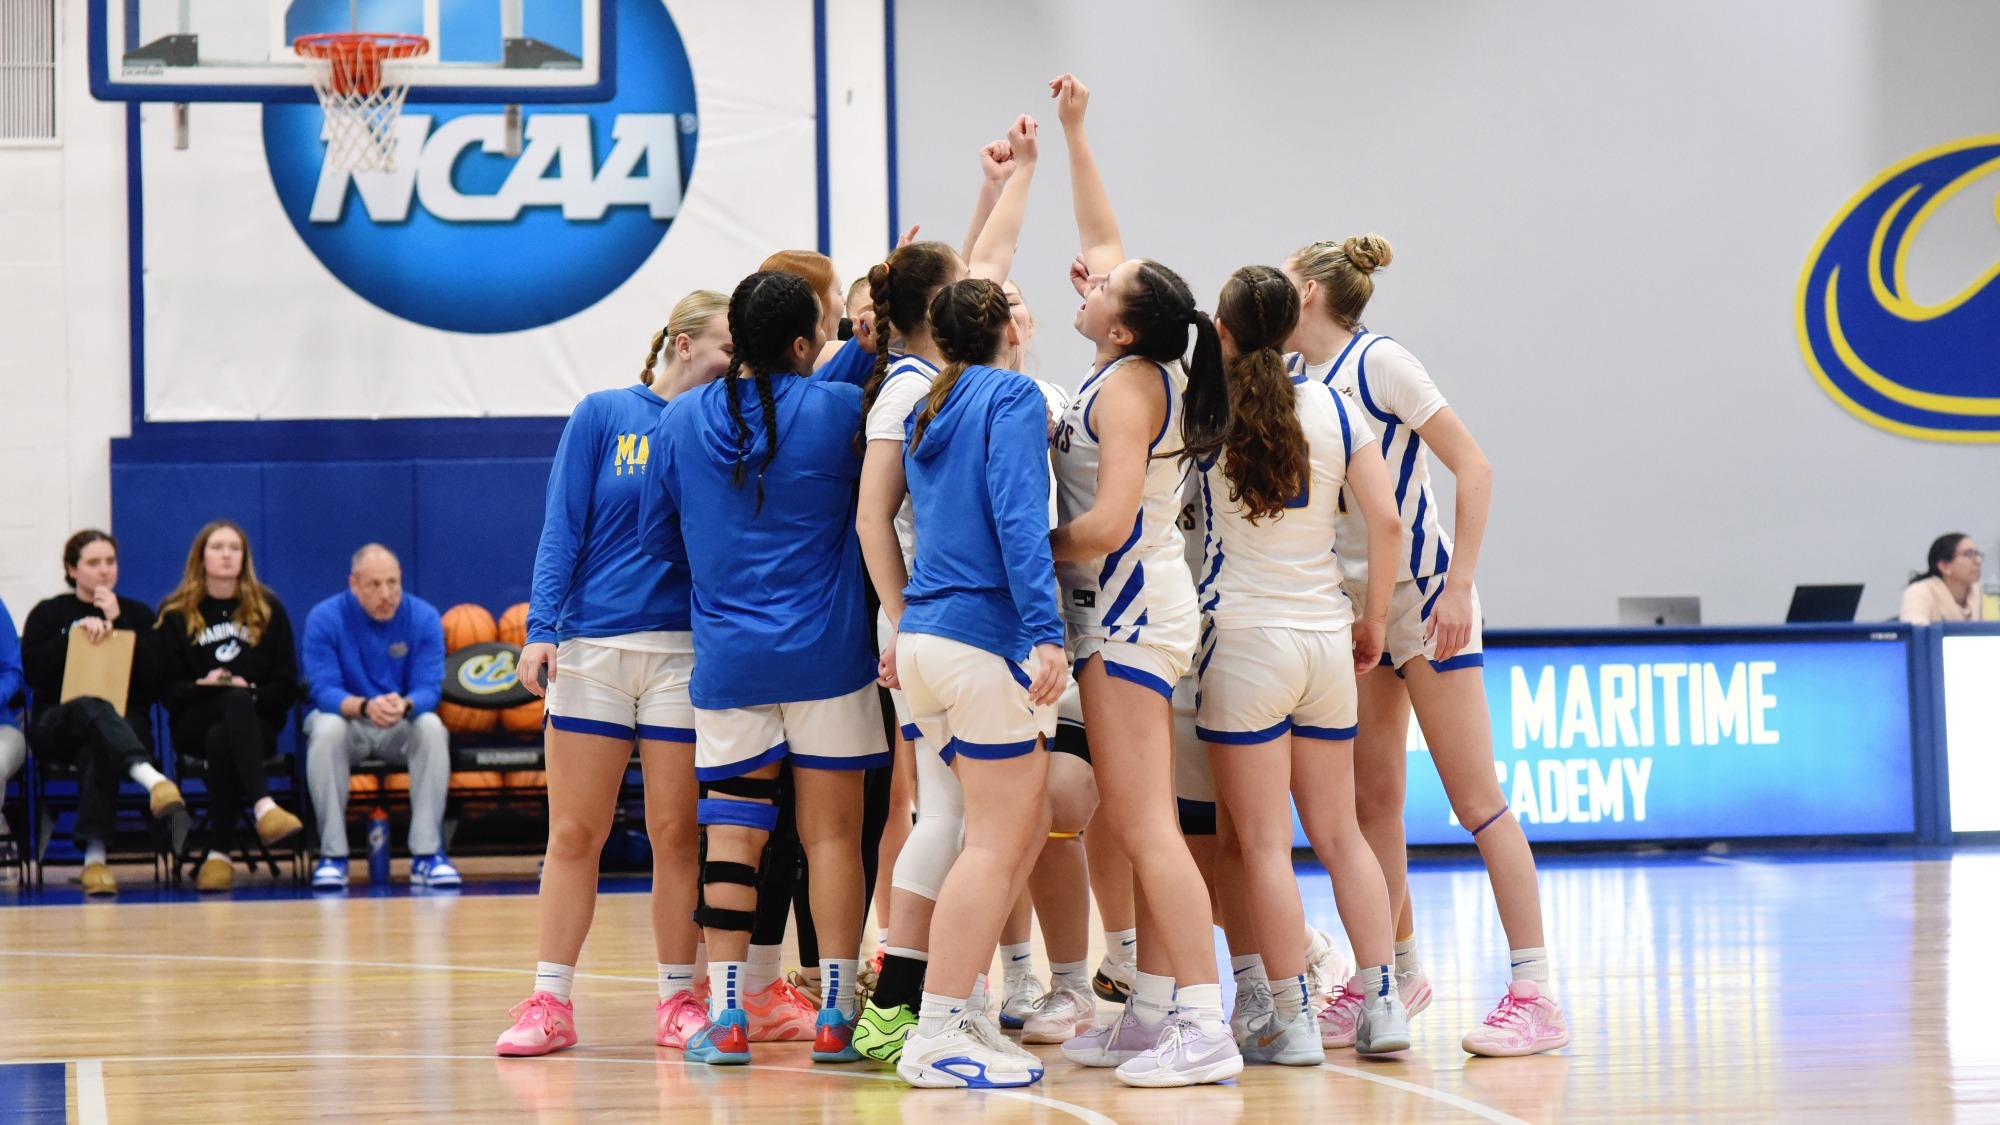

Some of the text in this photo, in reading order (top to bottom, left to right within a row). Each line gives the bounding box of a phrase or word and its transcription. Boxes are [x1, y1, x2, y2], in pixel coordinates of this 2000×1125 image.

[199, 621, 253, 647] MARINR
[1510, 661, 1780, 750] MARITIME
[1449, 757, 1653, 827] ADEMY
